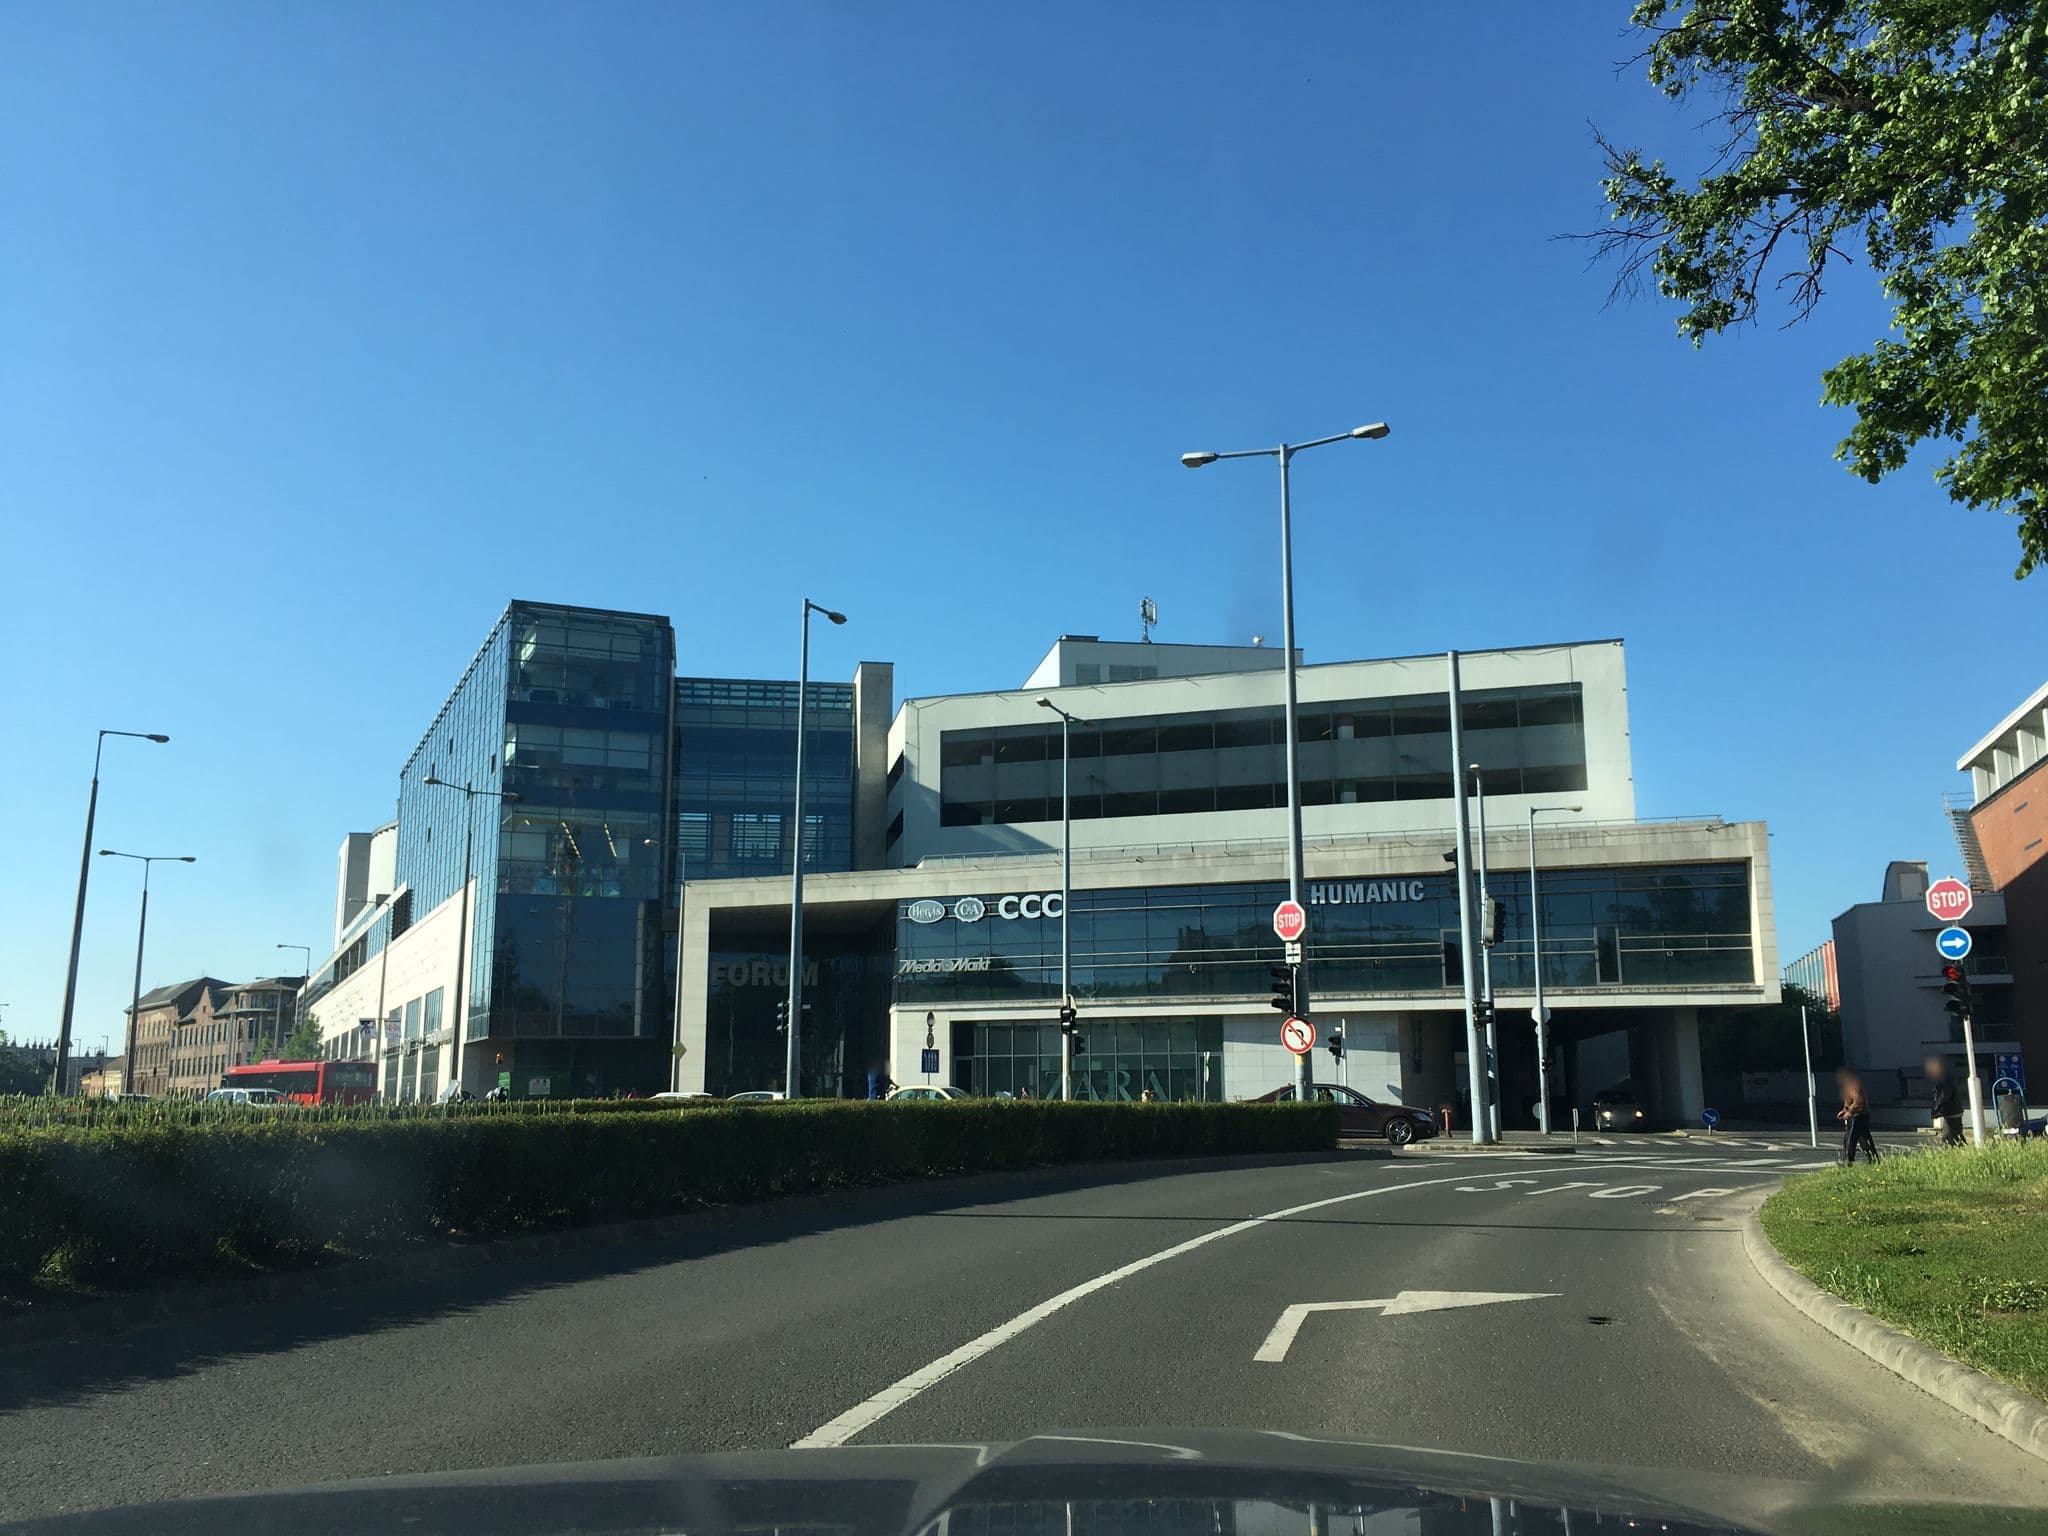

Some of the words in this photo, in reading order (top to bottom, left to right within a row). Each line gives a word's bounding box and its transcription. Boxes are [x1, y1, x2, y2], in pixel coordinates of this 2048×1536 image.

[1311, 881, 1424, 905] HUMANIC
[1931, 890, 1965, 909] STOP
[912, 905, 942, 919] Hervis
[960, 902, 980, 916] C&A
[998, 894, 1063, 920] CCC
[1278, 912, 1301, 929] STOP
[711, 960, 819, 987] FORUM
[1045, 1069, 1168, 1102] ZARA
[1454, 1179, 1738, 1202] STOP
